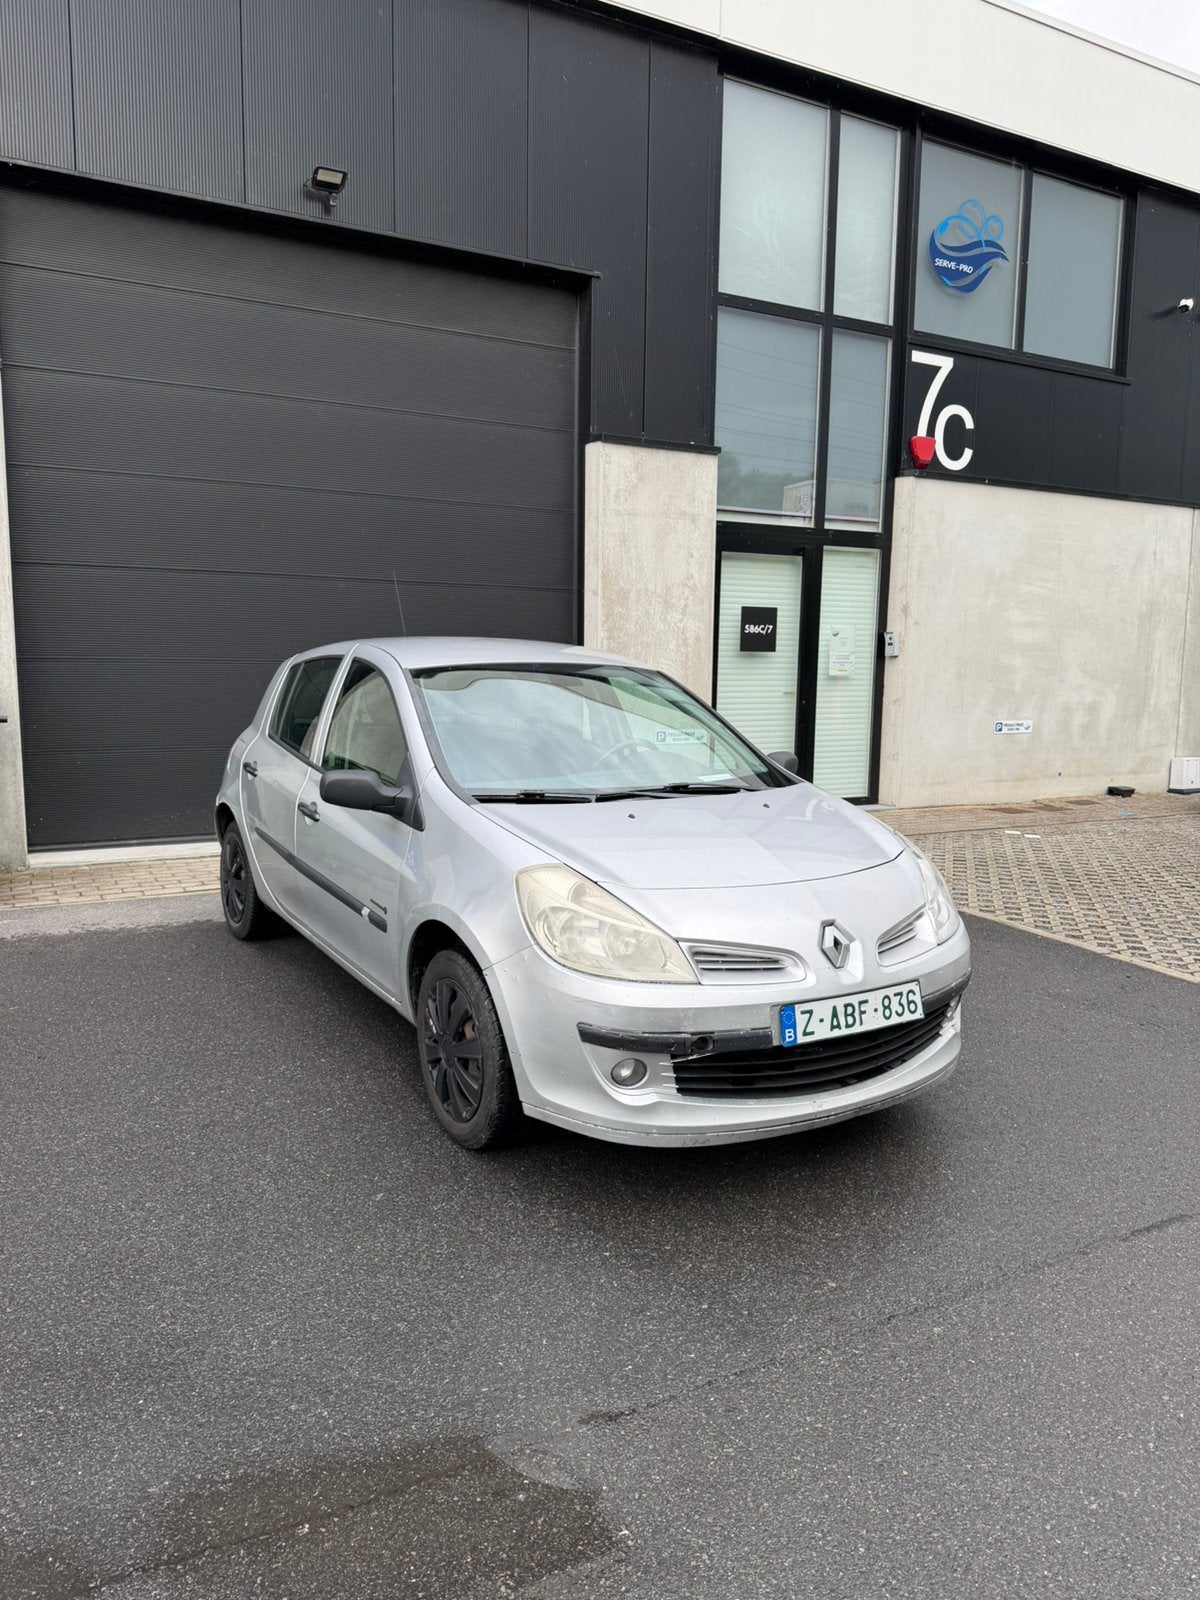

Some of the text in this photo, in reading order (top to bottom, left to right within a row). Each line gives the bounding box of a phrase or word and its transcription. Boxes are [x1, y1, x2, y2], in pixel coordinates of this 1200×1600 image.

[934, 257, 974, 274] SERVE-PRO
[744, 624, 774, 635] 586C/7
[785, 1029, 795, 1041] B
